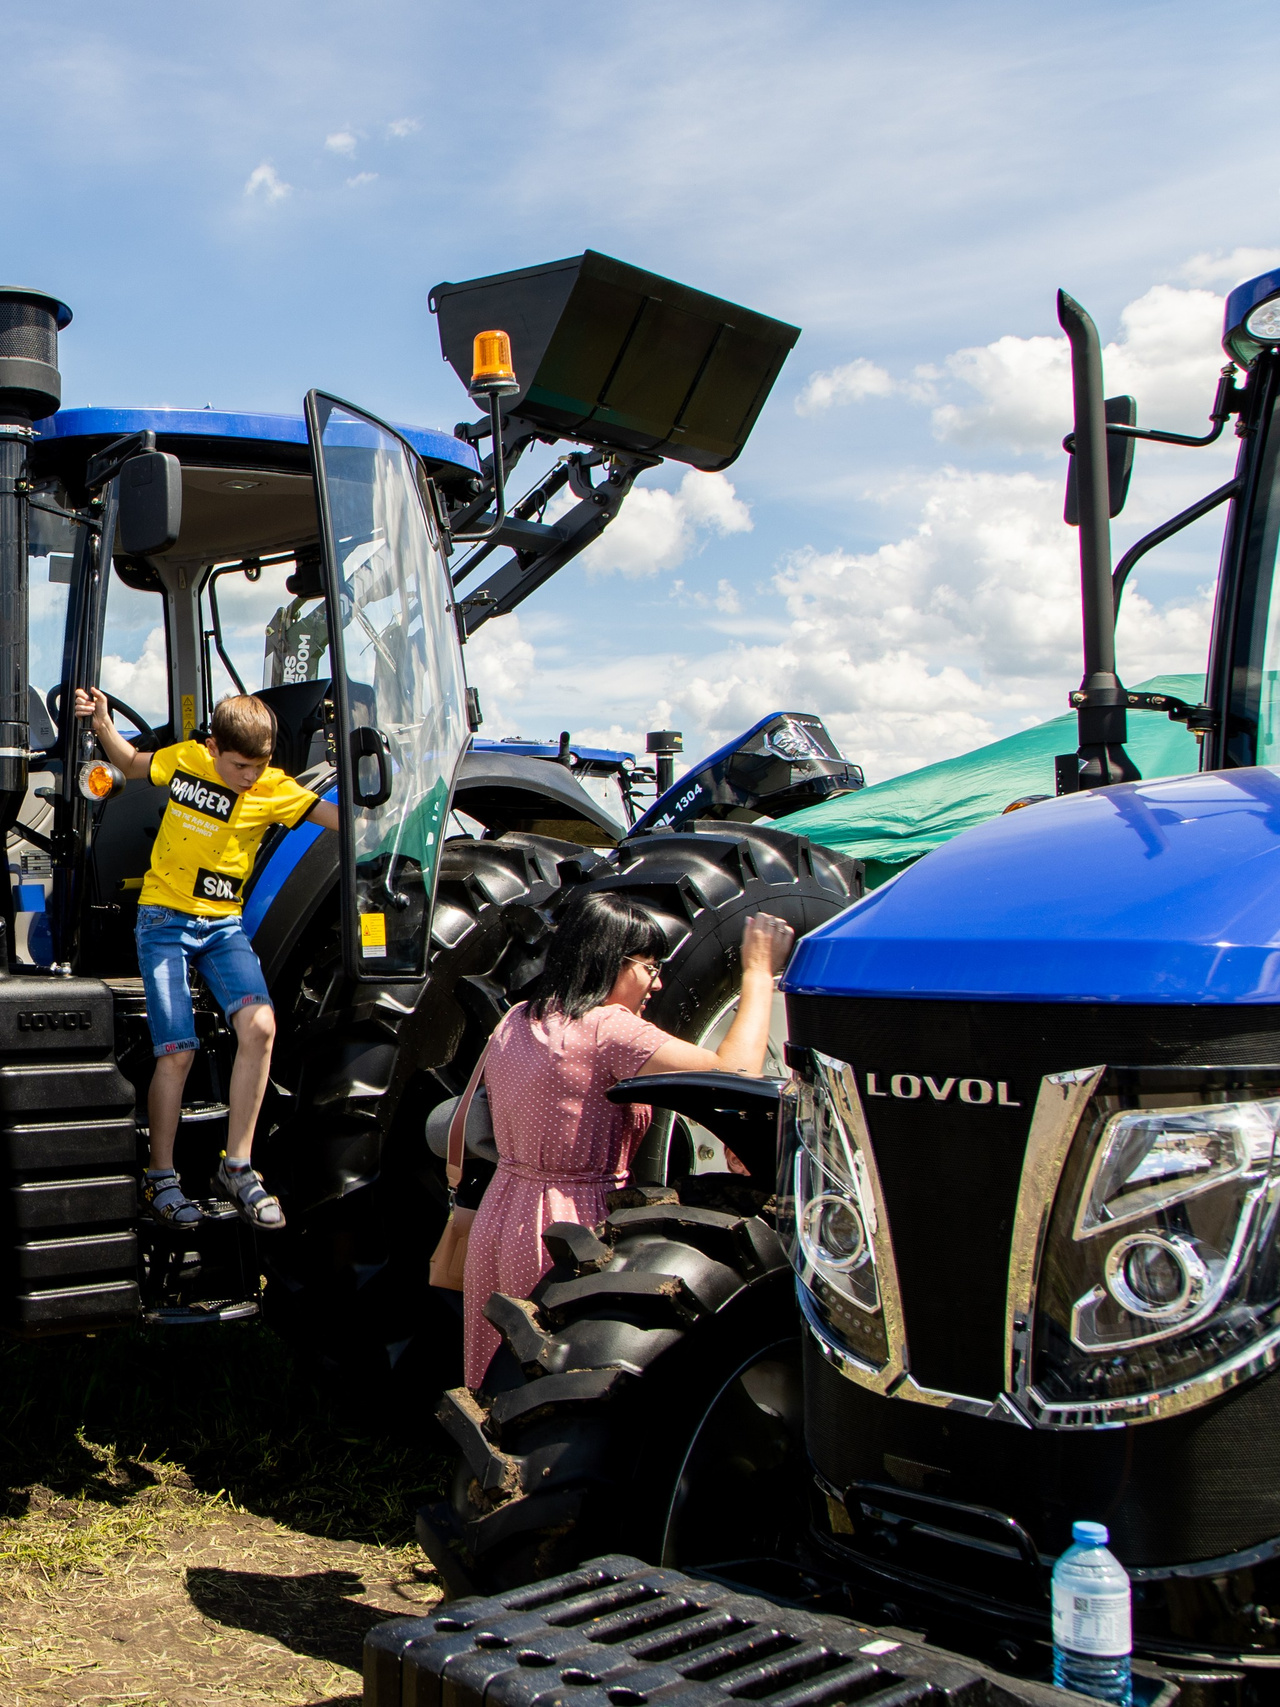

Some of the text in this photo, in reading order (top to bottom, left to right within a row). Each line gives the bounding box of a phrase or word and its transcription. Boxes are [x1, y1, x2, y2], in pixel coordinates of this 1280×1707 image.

[170, 777, 231, 816] DANGER
[675, 783, 703, 812] 1304
[19, 1011, 91, 1032] LOVOL
[866, 1072, 1022, 1107] LOVOL
